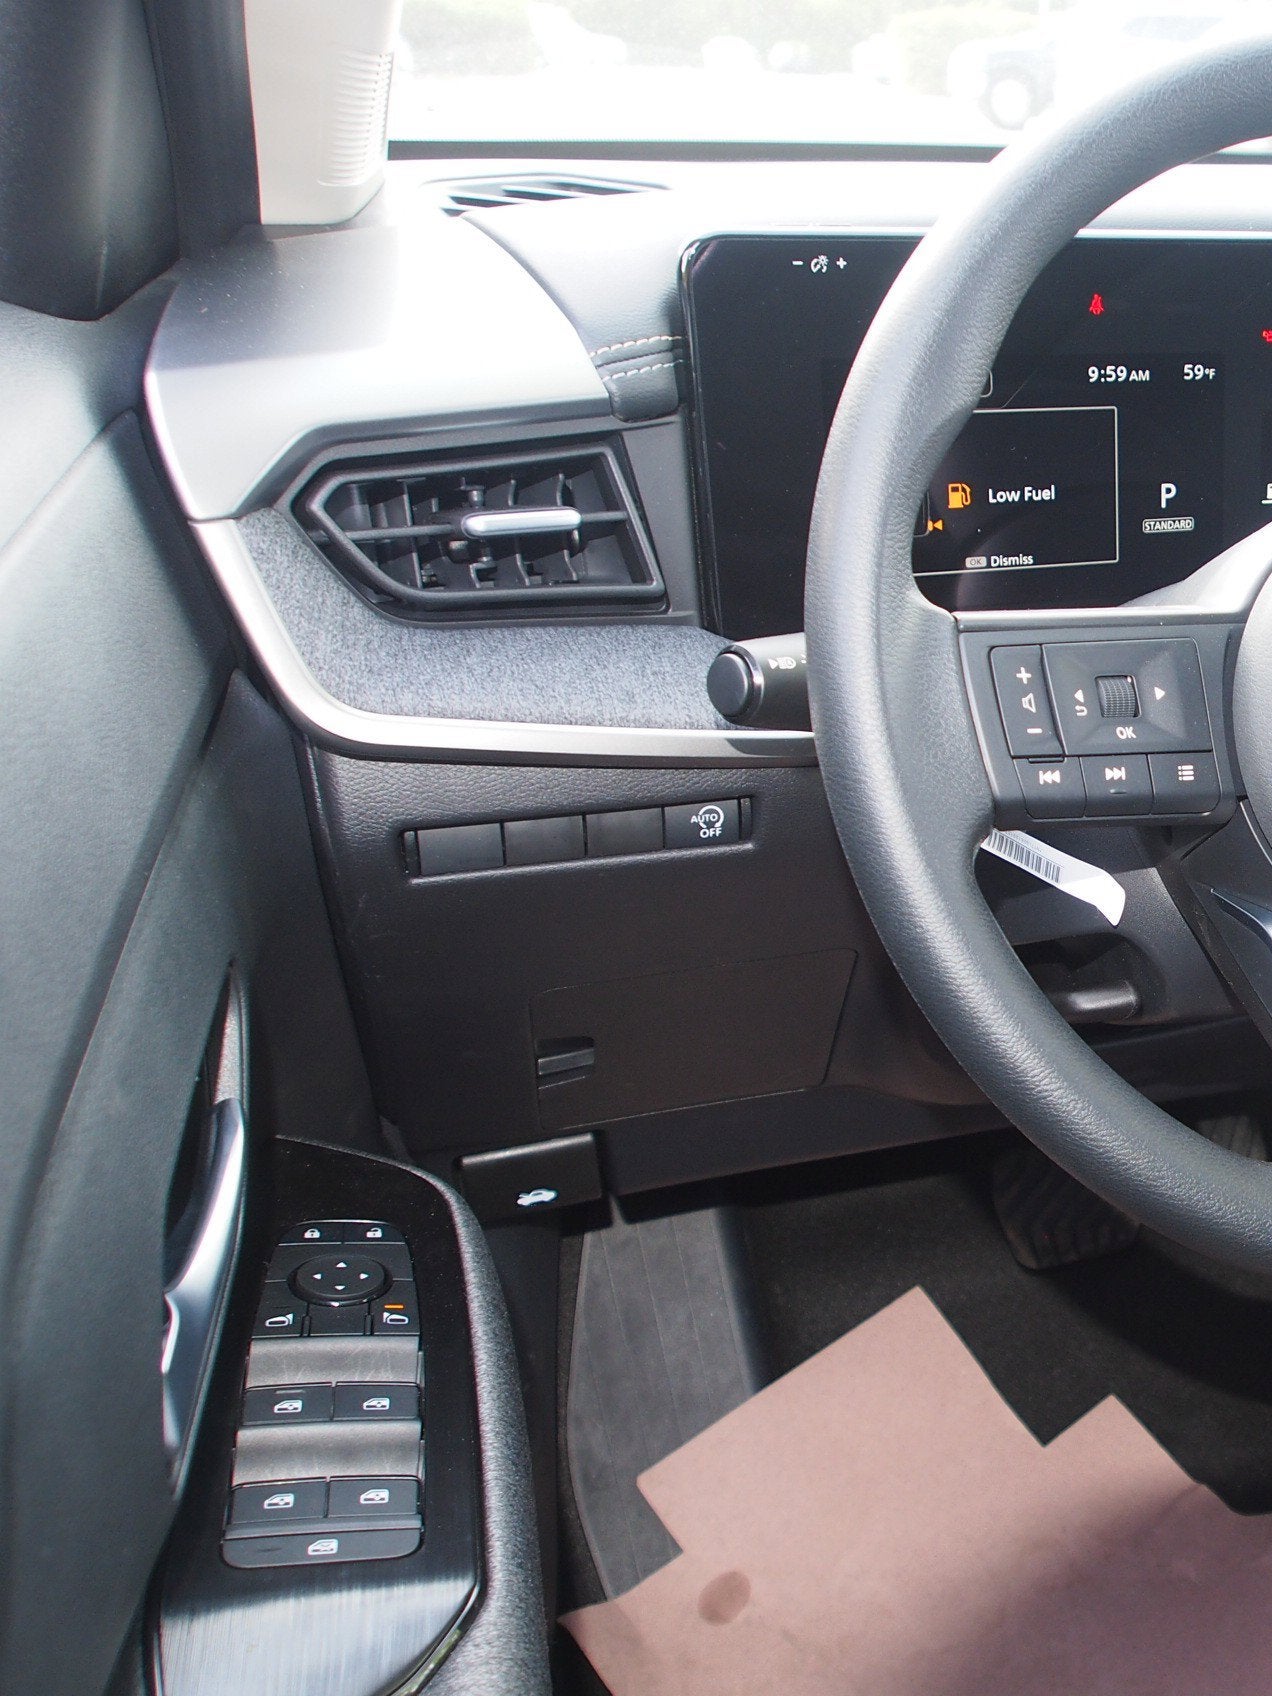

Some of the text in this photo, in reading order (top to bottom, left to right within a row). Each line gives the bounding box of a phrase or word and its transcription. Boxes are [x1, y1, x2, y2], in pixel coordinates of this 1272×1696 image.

[1088, 365, 1150, 383] 9:59 AM
[1183, 364, 1216, 380] 59°F
[988, 485, 1056, 503] Low Fuel
[1160, 483, 1177, 509] P
[1144, 520, 1193, 532] STANDARD
[990, 554, 1034, 568] Dismiss
[1115, 726, 1137, 740] OK
[690, 813, 718, 823] AUTO
[700, 827, 722, 838] OFF
